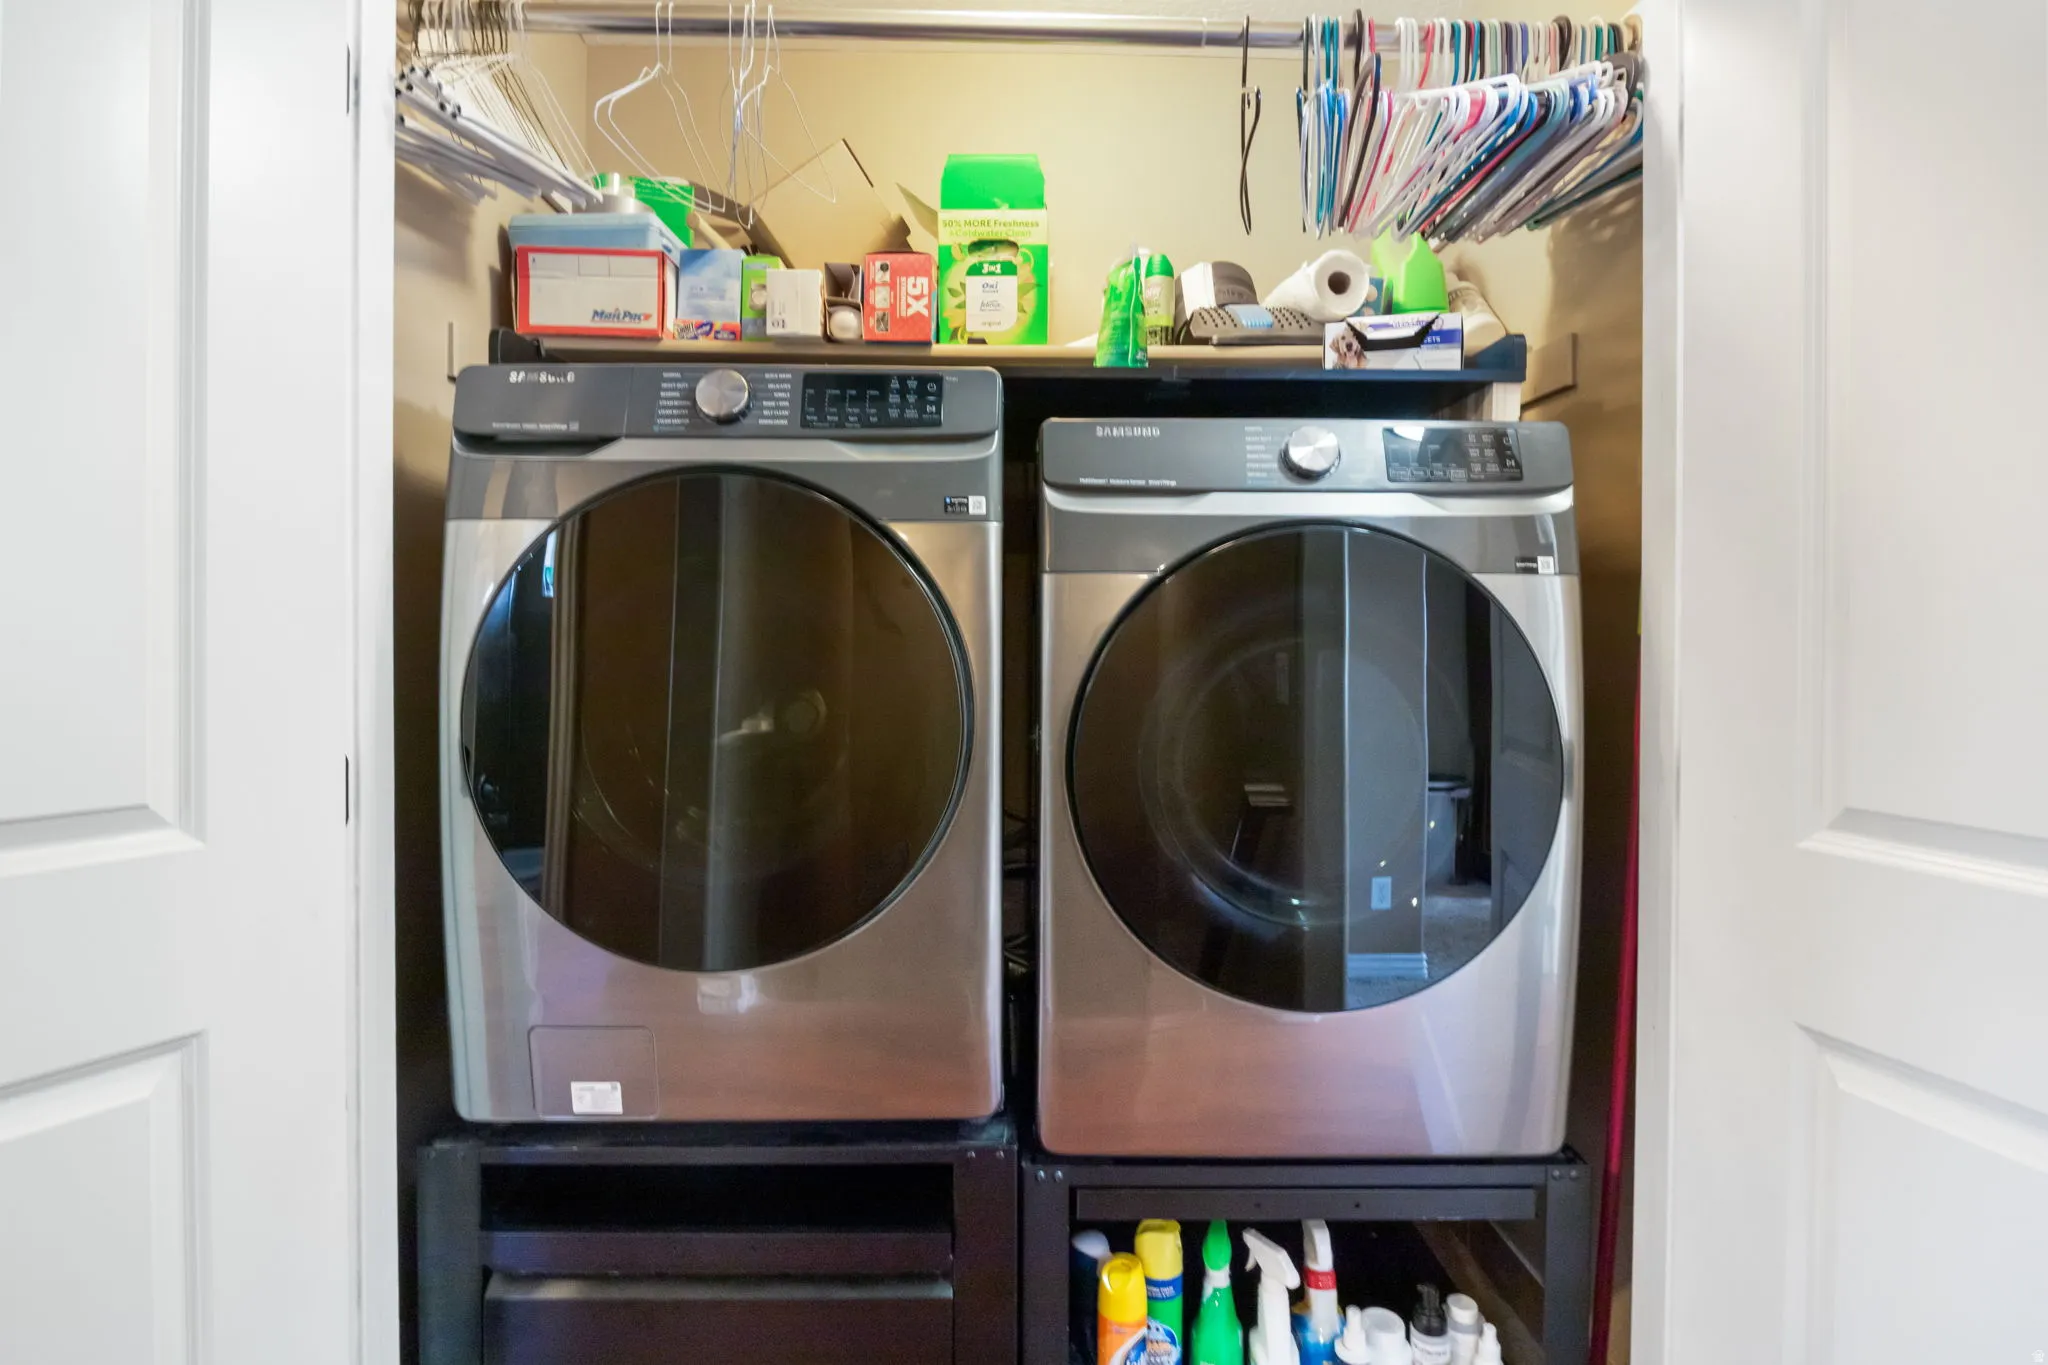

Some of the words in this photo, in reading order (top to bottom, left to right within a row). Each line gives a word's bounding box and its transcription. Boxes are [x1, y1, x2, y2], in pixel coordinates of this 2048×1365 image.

[963, 219, 992, 228] MORE
[993, 219, 1040, 228] Freshness
[907, 275, 929, 318] 5X
[509, 370, 575, 384] SASUG
[1096, 425, 1160, 438] SAMSUNG
